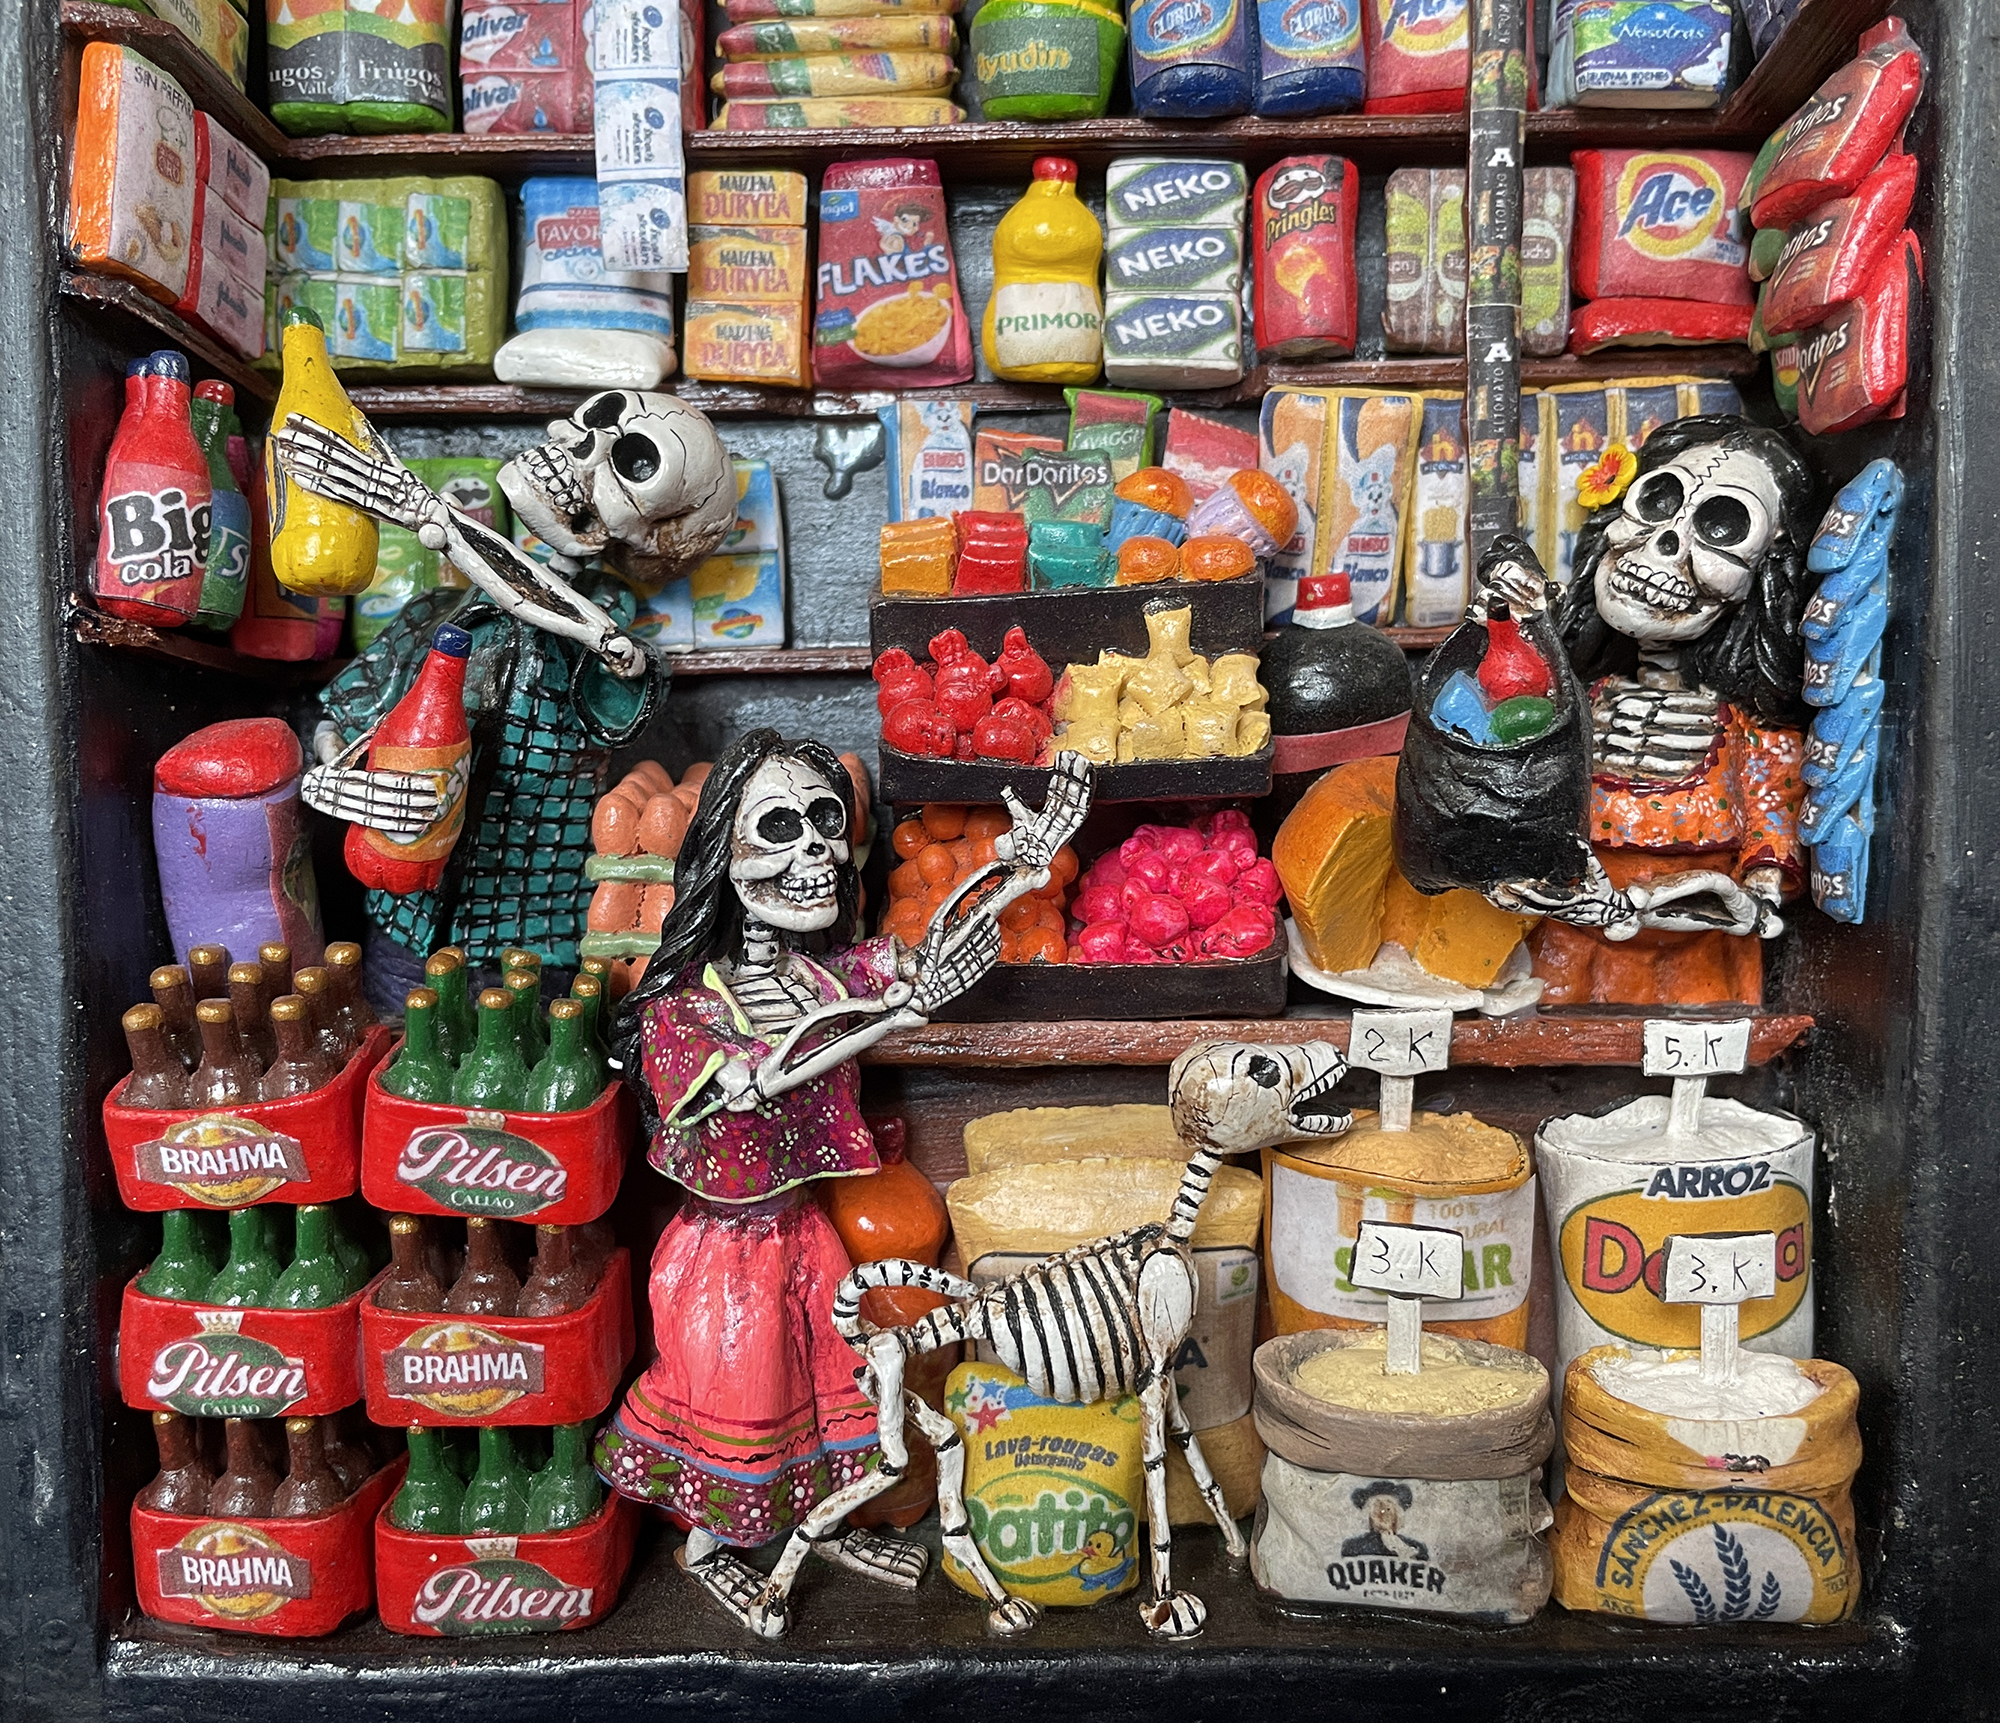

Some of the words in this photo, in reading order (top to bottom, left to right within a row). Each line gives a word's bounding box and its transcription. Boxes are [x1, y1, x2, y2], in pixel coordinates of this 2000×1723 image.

[463, 13, 528, 43] olivar
[1618, 23, 1705, 40] Nosotras
[269, 65, 324, 88] ugos
[464, 86, 517, 112] olivar
[1122, 169, 1232, 213] NEKO
[1618, 171, 1716, 239] Ace
[1265, 200, 1337, 252] Pringles
[816, 244, 950, 300] FLAKES
[1117, 236, 1227, 278] NEKO
[996, 312, 1099, 336] PRIMOR
[1114, 304, 1224, 345] NEKO
[920, 478, 970, 499] Blanco
[1026, 463, 1108, 487] Doritos
[107, 489, 212, 566] Big
[120, 550, 192, 584] cola
[160, 1142, 288, 1175] BRAHMA
[398, 1130, 568, 1198] Pilsen
[1646, 1161, 1772, 1198] ARROZ
[449, 1191, 515, 1209] CALLAO
[146, 1342, 307, 1398] Pilsen
[403, 1353, 529, 1385] BRAHMA
[199, 1402, 261, 1418] CALLAO
[181, 1556, 294, 1590] BRAHMA
[1326, 1559, 1447, 1595] QUAKER
[413, 1568, 594, 1623] Pilsen
